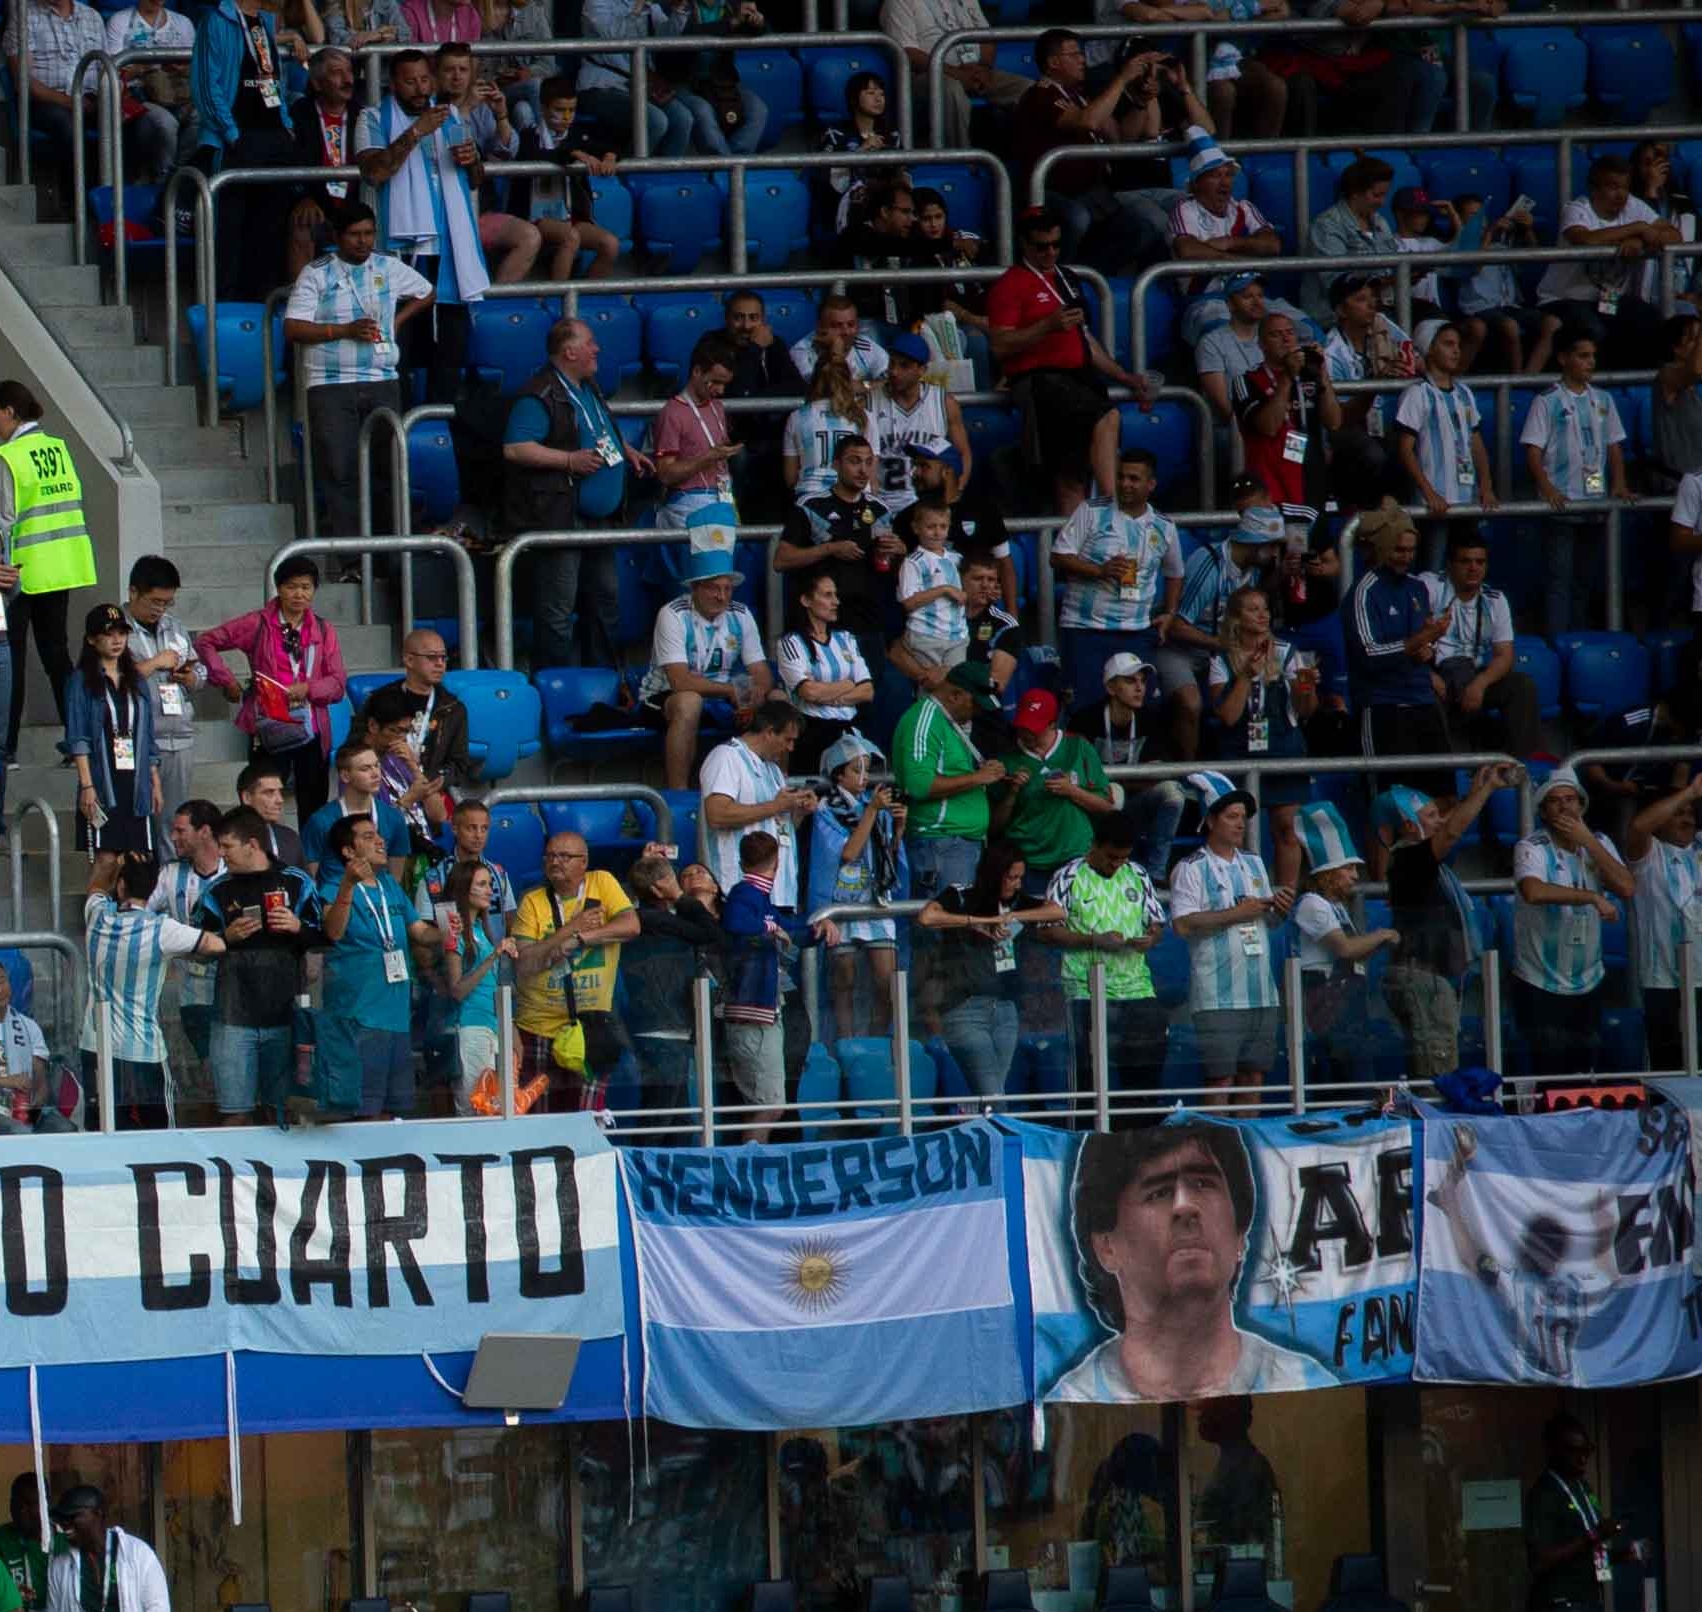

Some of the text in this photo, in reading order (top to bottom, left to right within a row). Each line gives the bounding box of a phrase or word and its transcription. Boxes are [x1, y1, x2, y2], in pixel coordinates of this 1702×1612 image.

[31, 447, 66, 480] 5397
[635, 1115, 994, 1218] HENDERSON
[127, 1144, 587, 1312] CUARTO
